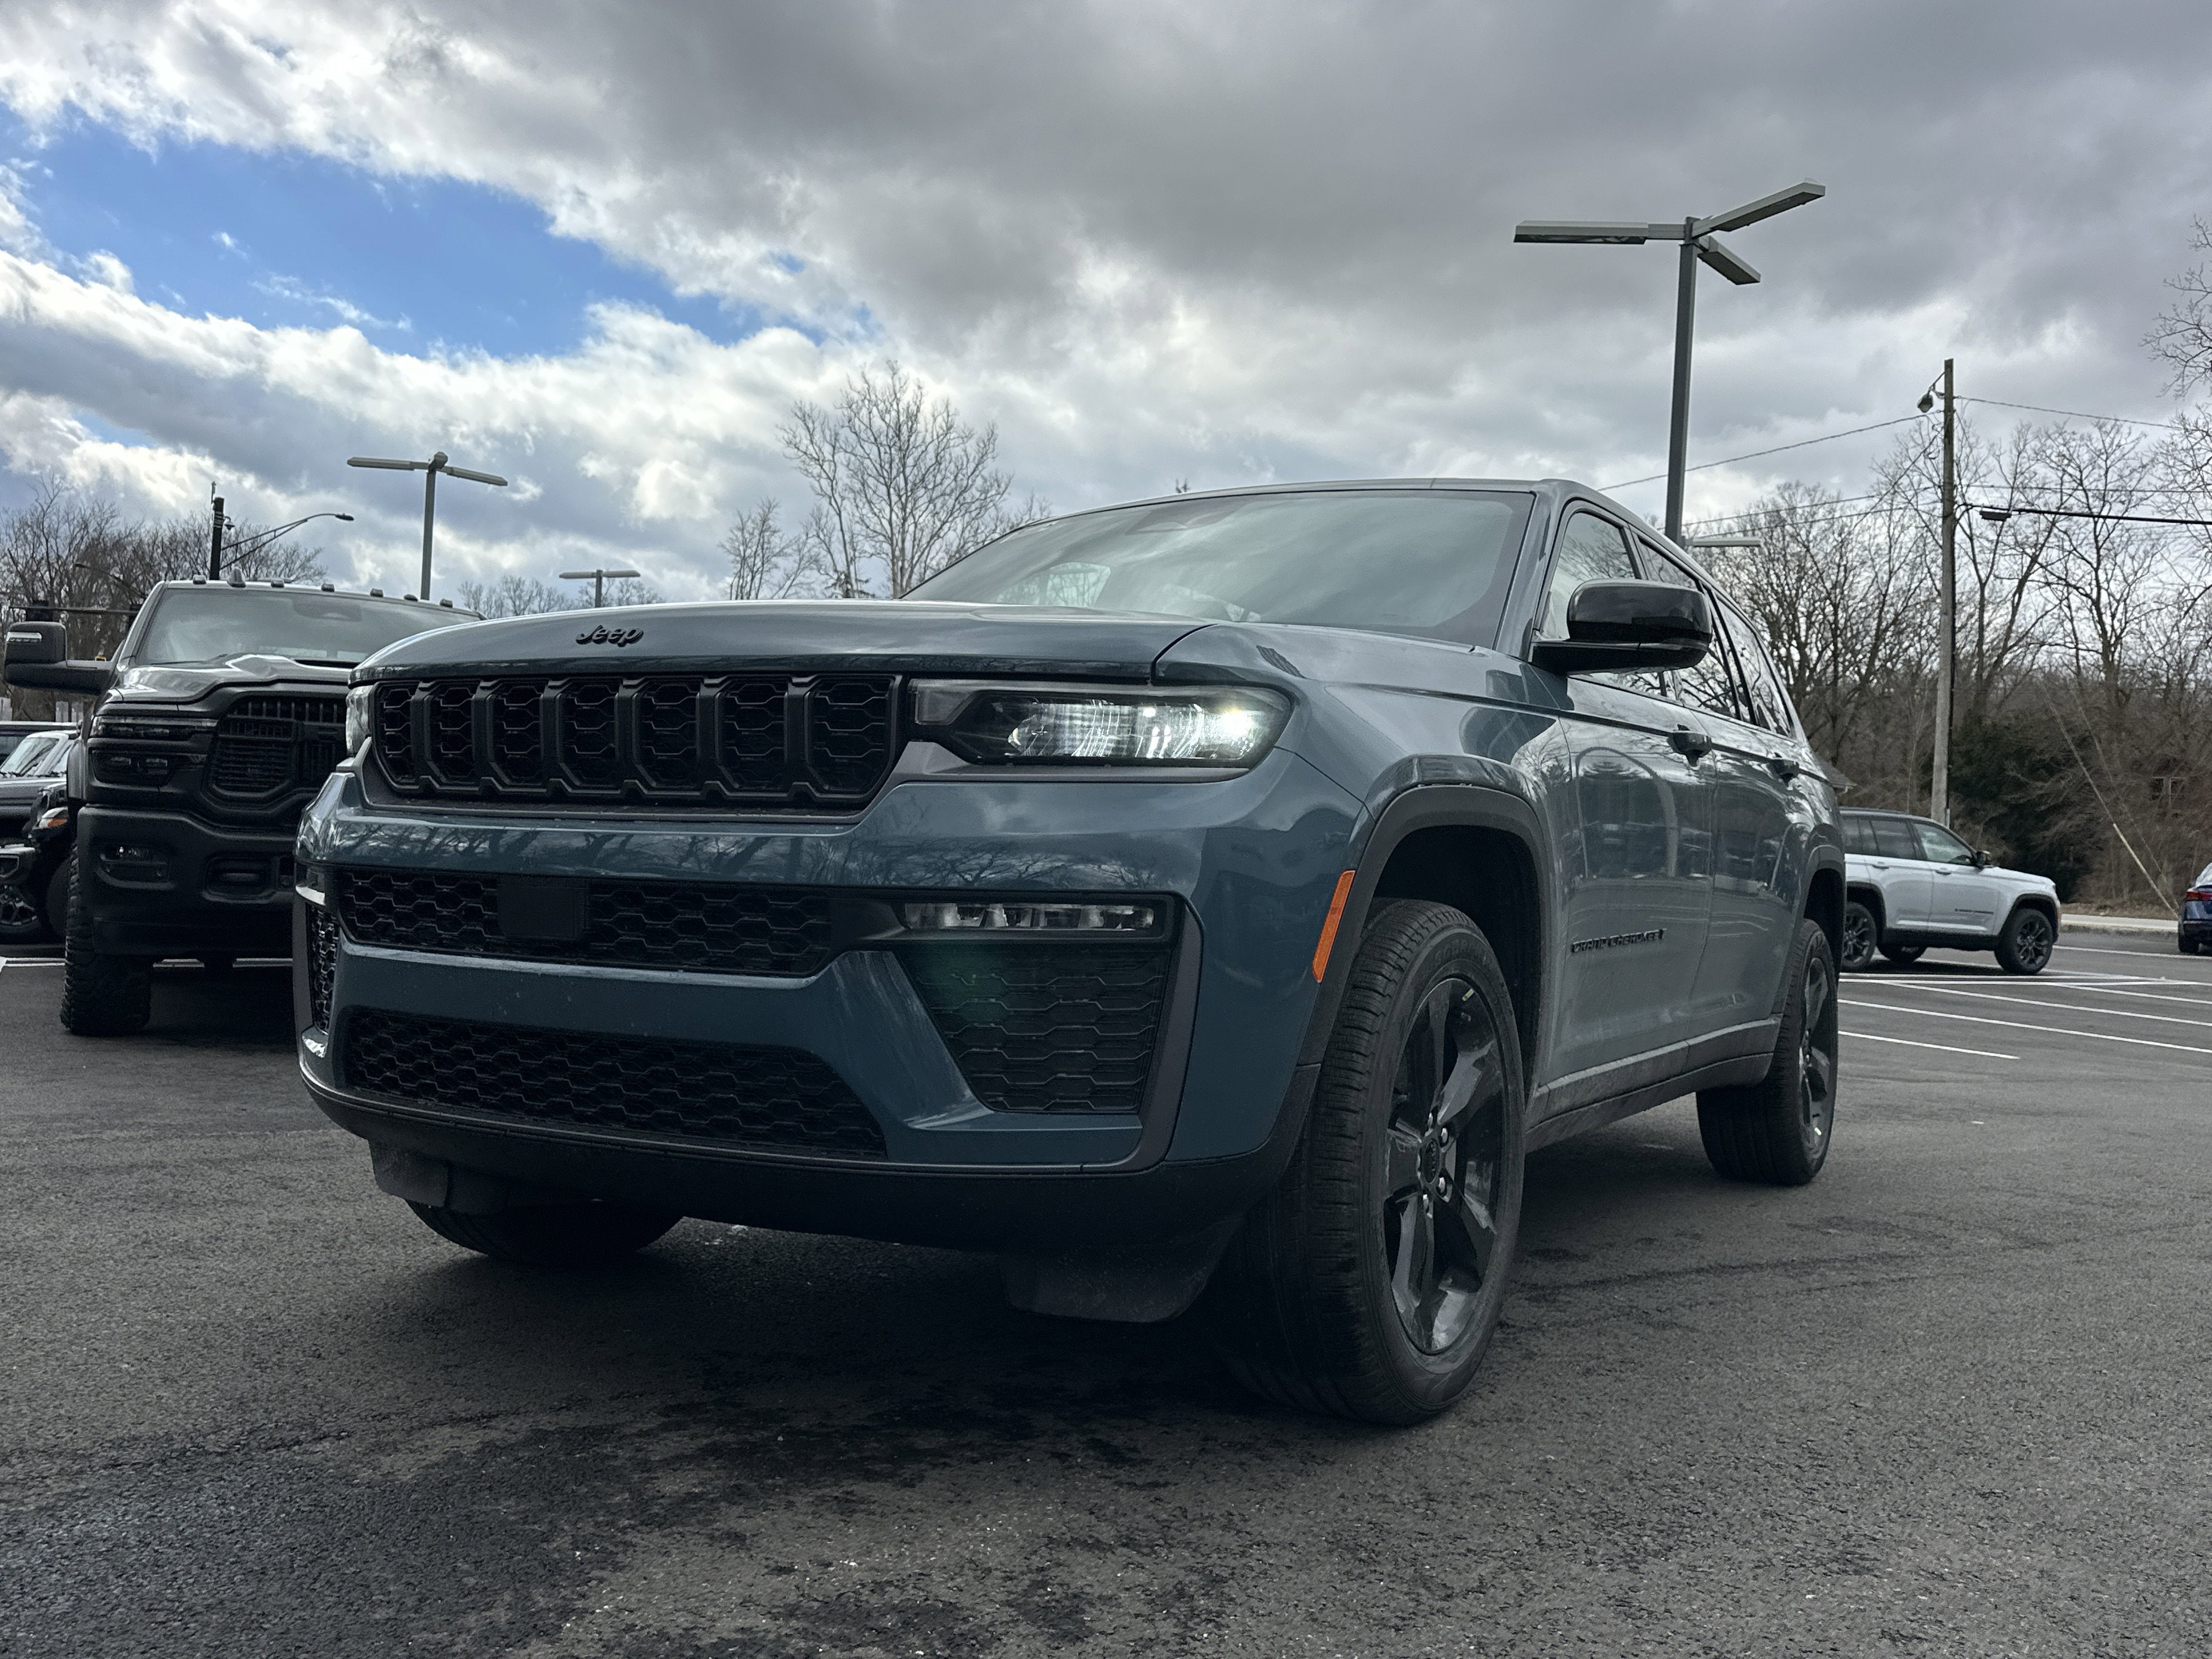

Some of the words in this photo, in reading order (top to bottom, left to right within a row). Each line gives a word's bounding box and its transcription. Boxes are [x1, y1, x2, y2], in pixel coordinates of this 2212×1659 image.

[575, 625, 644, 647] Jeep
[1572, 937, 1609, 952] GRAND
[1609, 929, 1659, 947] CHEROKEE
